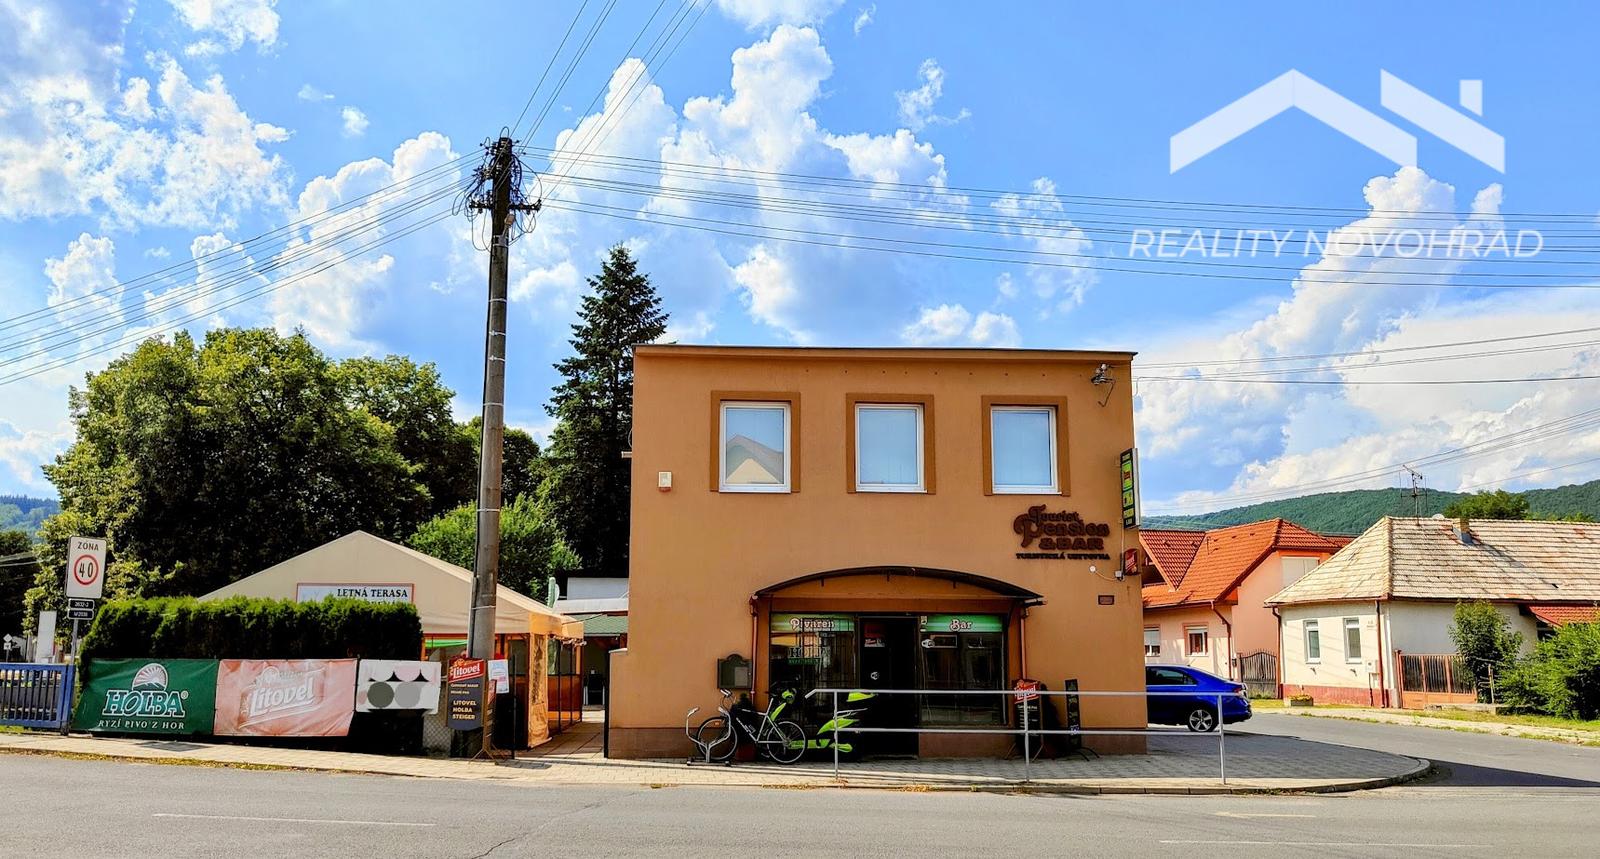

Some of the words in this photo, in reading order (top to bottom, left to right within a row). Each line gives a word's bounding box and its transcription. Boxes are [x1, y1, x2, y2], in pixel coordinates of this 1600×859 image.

[79, 561, 94, 578] 40
[337, 586, 368, 598] LETNÁ
[371, 588, 408, 598] TERASA
[949, 619, 973, 632] Bar
[452, 662, 480, 679] Litovel
[247, 675, 315, 719] Litovel
[98, 719, 121, 728] RYZÍ
[124, 721, 148, 729] PIVO
[151, 721, 159, 729] Z
[162, 722, 185, 730] HOR
